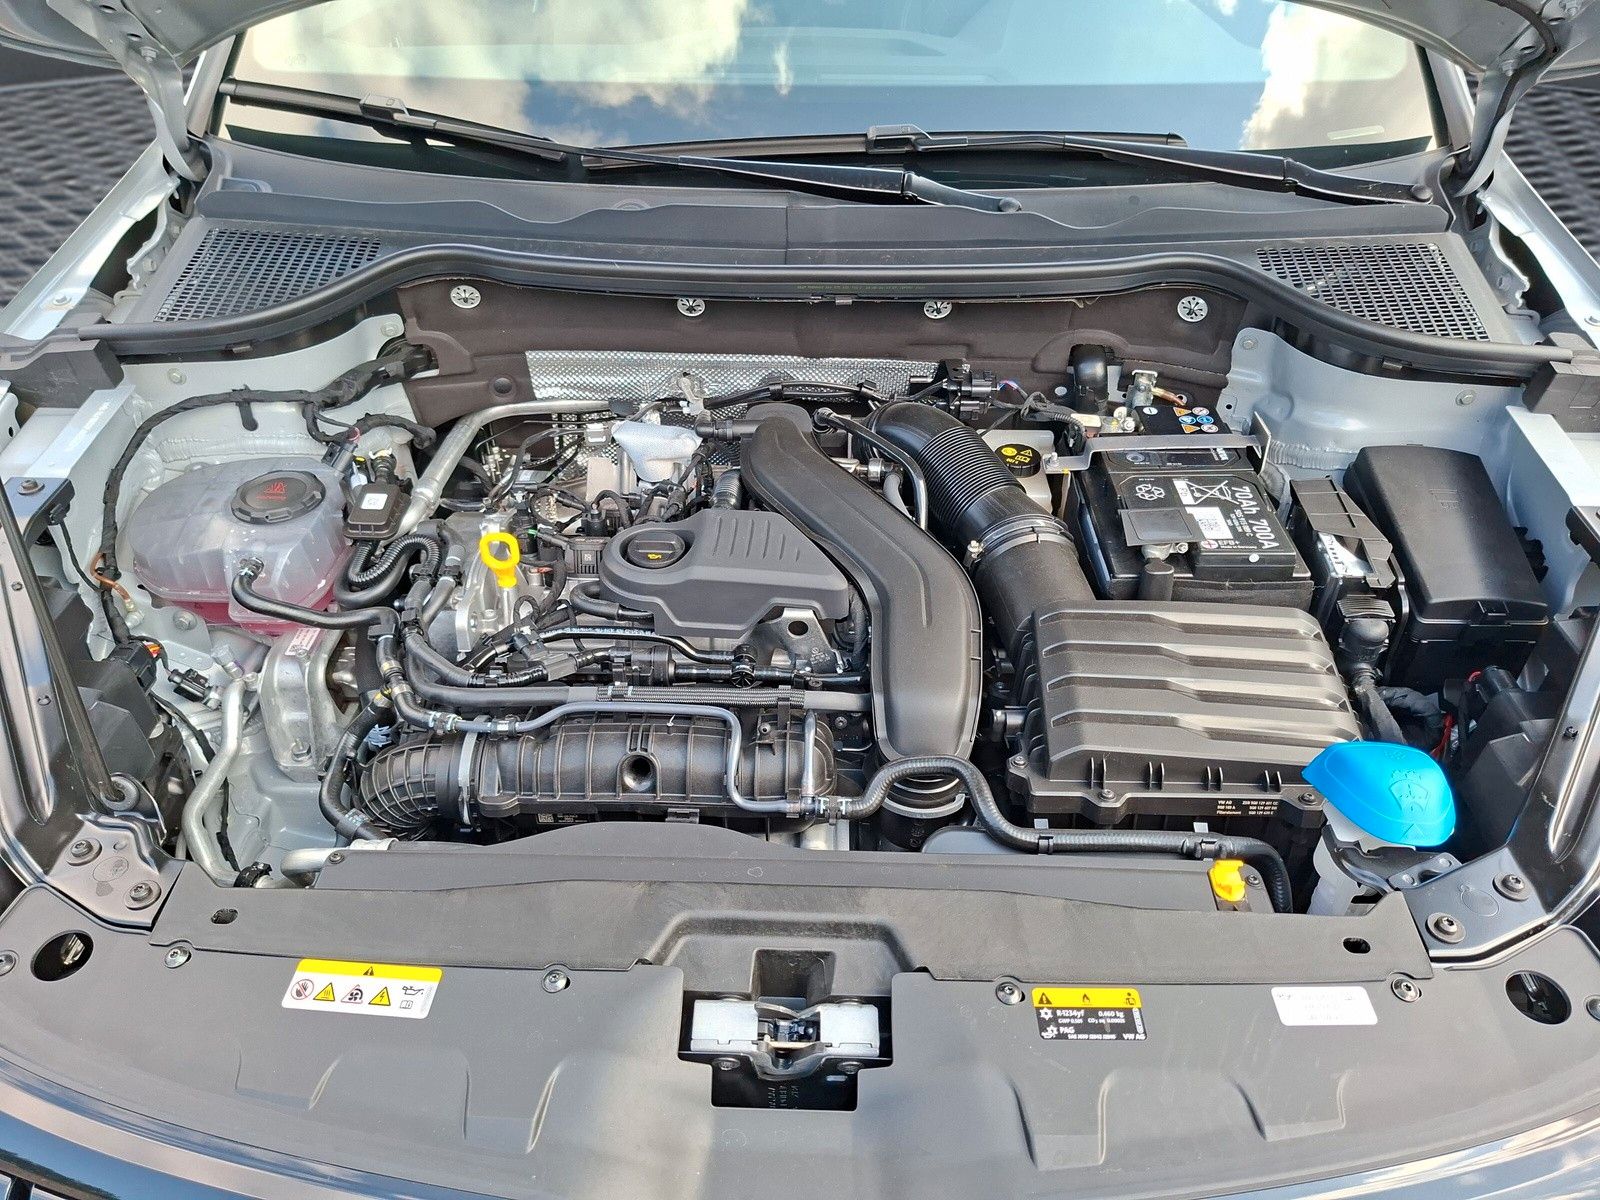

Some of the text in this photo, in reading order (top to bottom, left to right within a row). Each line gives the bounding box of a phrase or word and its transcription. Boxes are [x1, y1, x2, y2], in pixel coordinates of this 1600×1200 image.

[1231, 486, 1261, 515] 70Ah
[1248, 518, 1280, 550] 700A
[1056, 1009, 1085, 1018] R-1234yf
[1060, 1026, 1075, 1034] PAG
